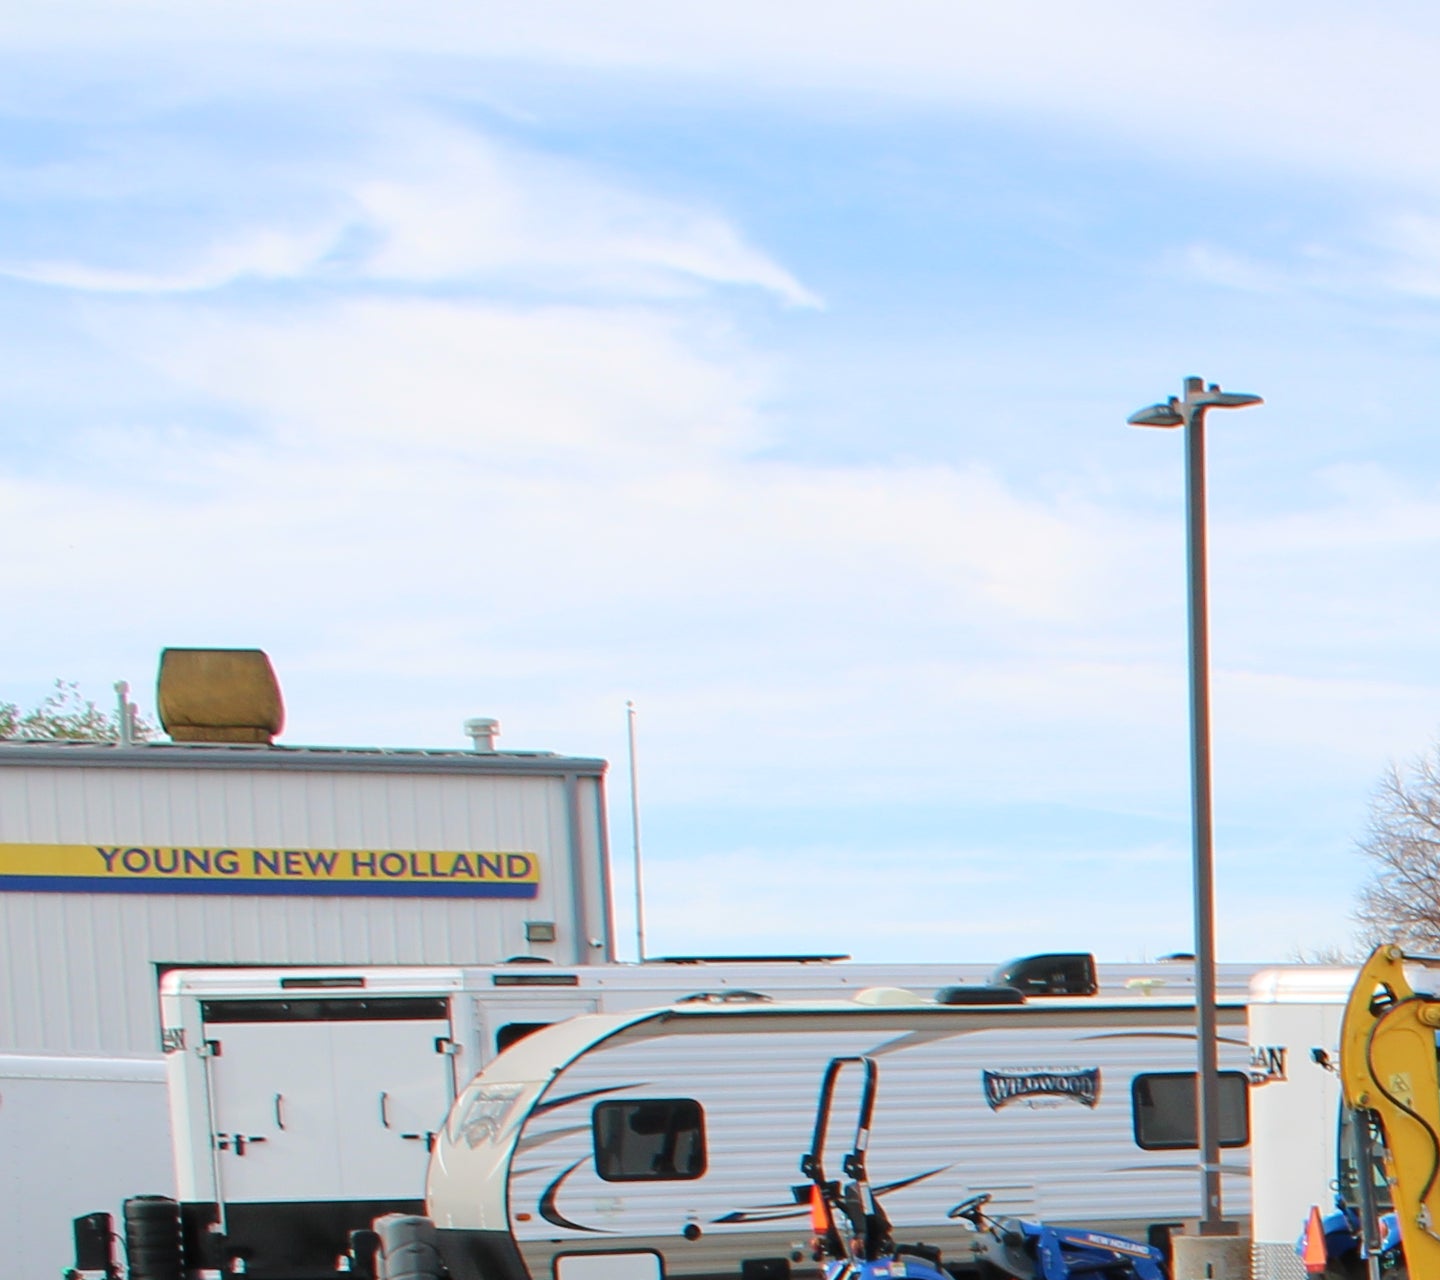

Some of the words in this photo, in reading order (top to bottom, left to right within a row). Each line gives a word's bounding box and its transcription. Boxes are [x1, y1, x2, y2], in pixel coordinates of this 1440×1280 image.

[97, 847, 239, 874] YOUNG
[253, 850, 340, 877] NEW
[352, 852, 533, 879] HOLLAND
[989, 1076, 1095, 1101] WILDWOOD
[1110, 1238, 1150, 1254] HOLLAND
